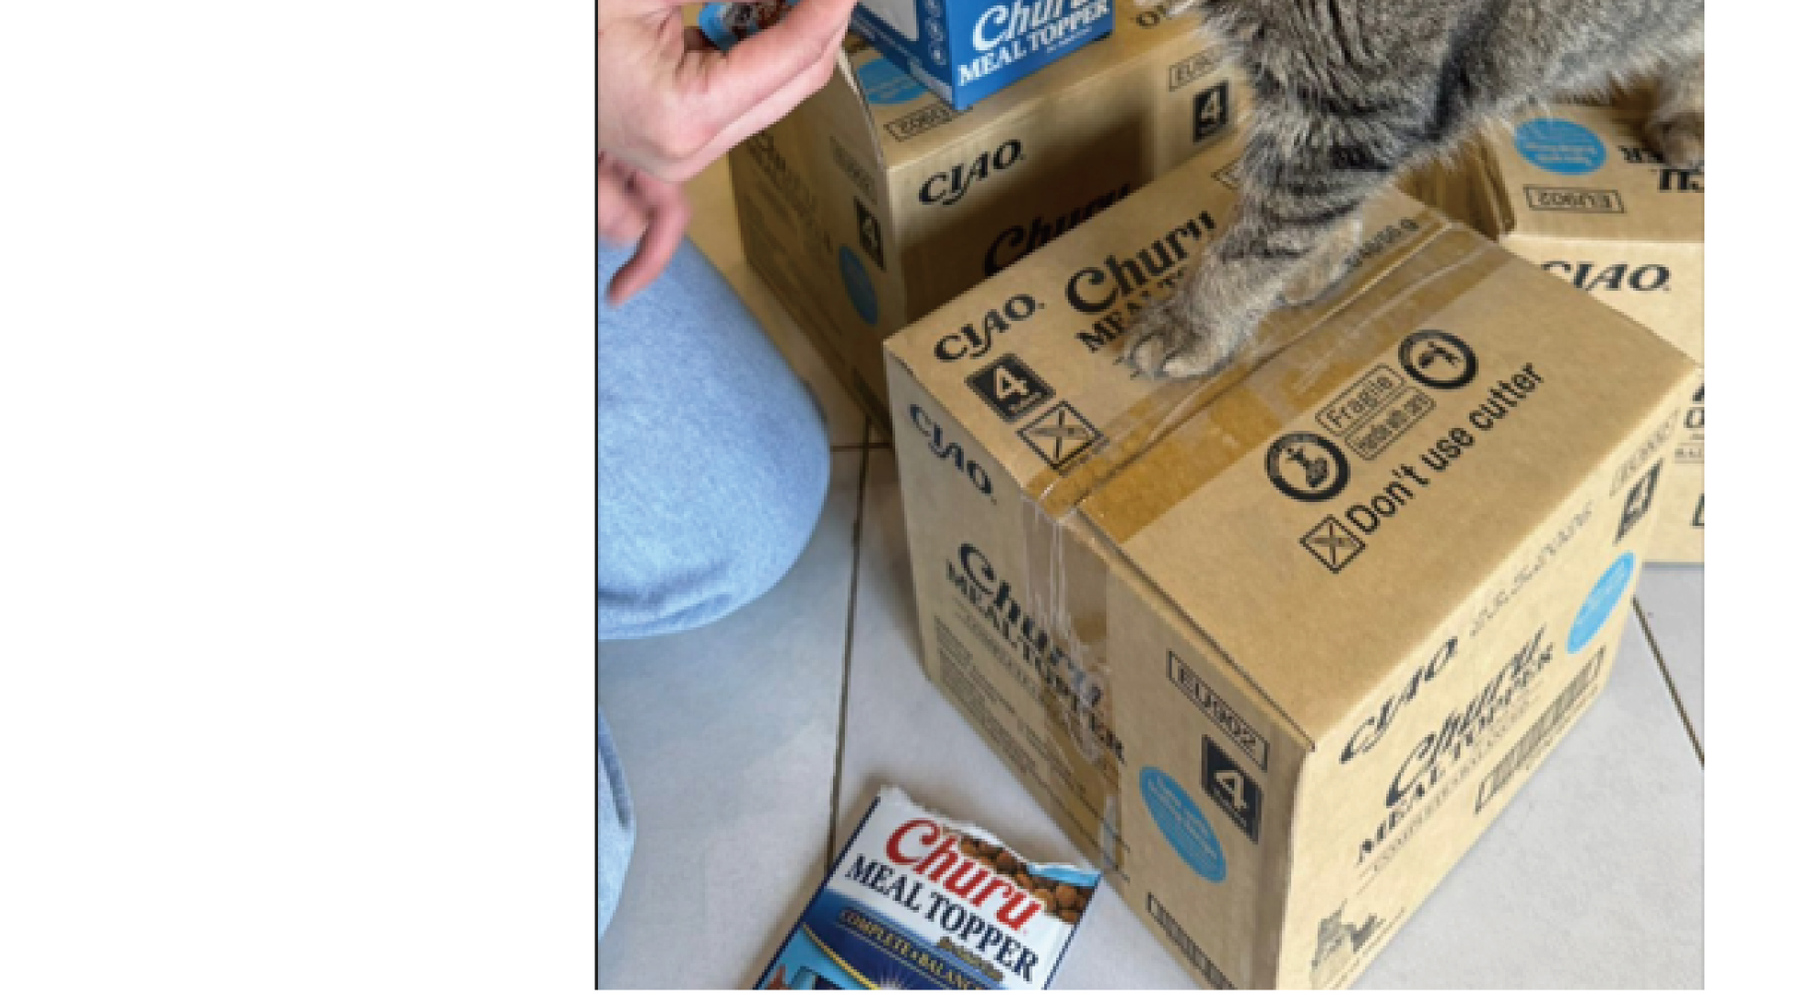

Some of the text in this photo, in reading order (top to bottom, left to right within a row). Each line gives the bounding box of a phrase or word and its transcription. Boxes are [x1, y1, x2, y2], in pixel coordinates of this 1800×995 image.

[957, 40, 1027, 87] MEAL
[918, 138, 1021, 205] CIAO
[934, 293, 1037, 363] CIAO
[993, 364, 1029, 402] 4
[1326, 373, 1396, 430] Fragile
[909, 403, 992, 494] CIAO
[1345, 362, 1545, 535] Don't use cutter
[1178, 661, 1257, 750] EU902
[1339, 636, 1458, 764] CIAO
[1386, 623, 1546, 808] Churu
[1214, 769, 1248, 810] 4
[1357, 757, 1443, 865] MEAL
[845, 852, 923, 913] MEAL
[926, 890, 1040, 983] TOPPER
[885, 817, 1043, 932] Churu
